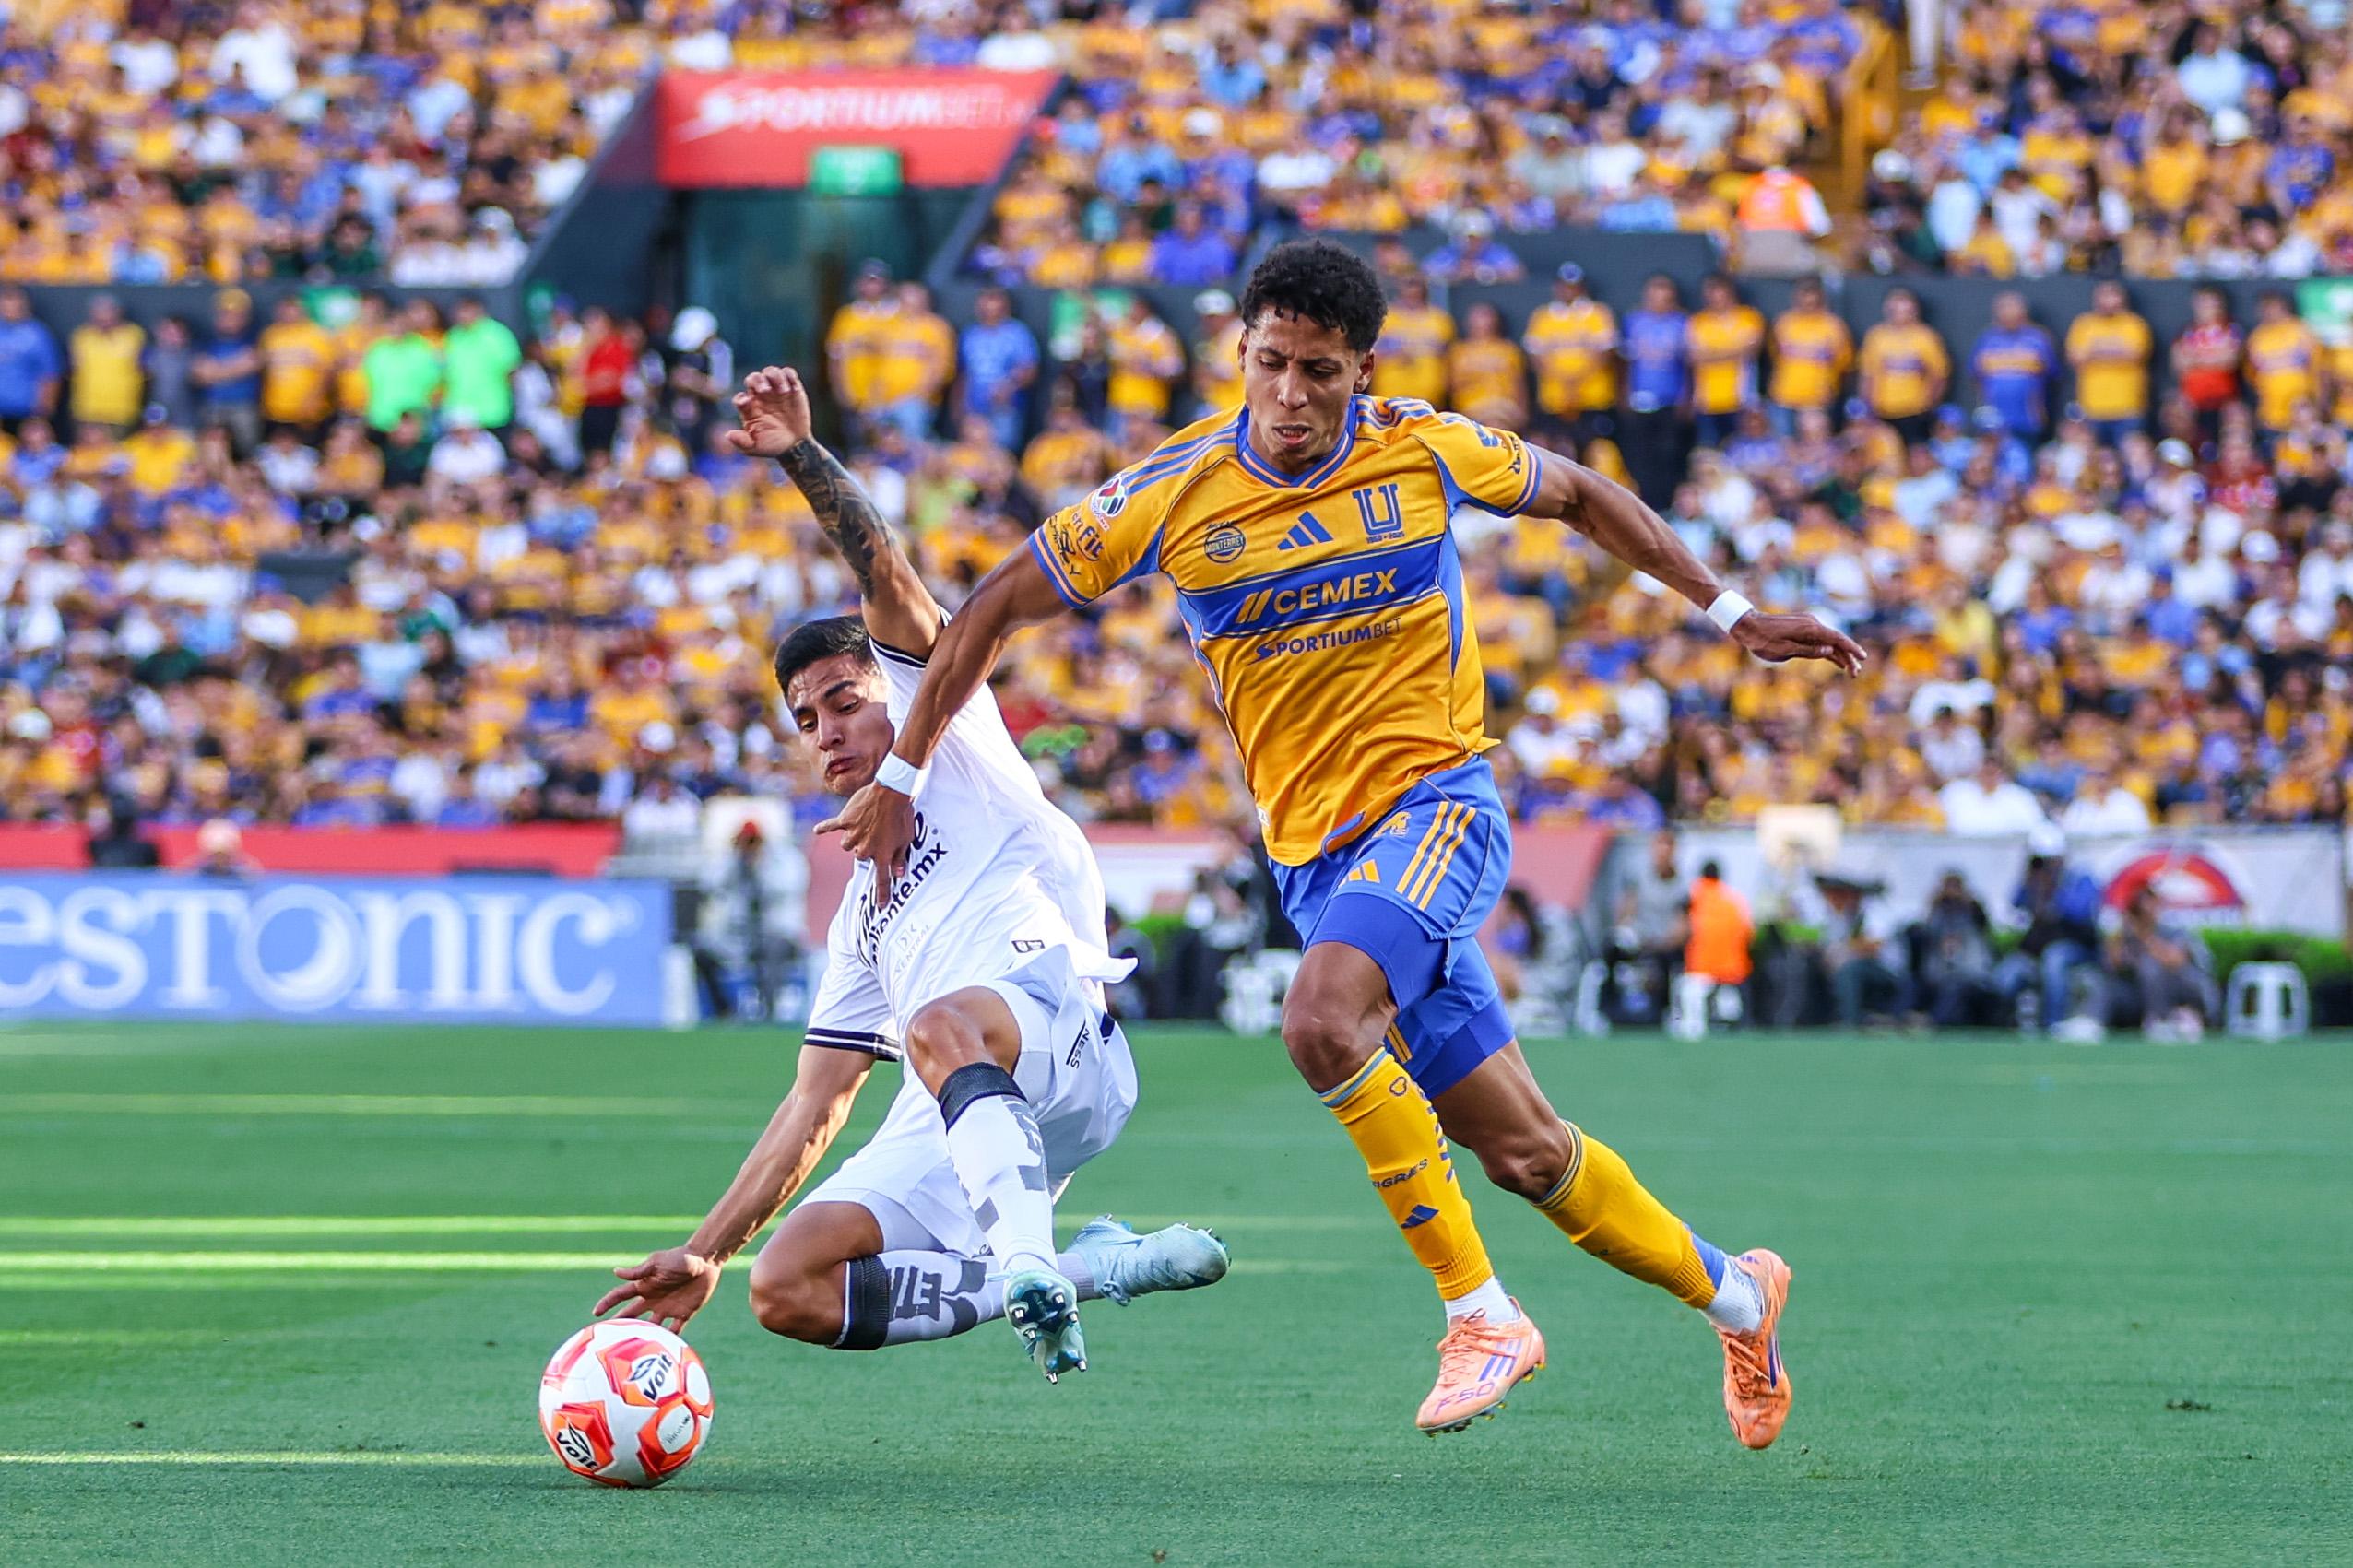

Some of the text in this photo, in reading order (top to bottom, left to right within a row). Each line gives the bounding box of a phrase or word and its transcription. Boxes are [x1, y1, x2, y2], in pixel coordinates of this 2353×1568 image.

[1352, 483, 1401, 535] U
[1273, 567, 1398, 615] CEMEX
[1246, 617, 1401, 666] SPORTIUMBET
